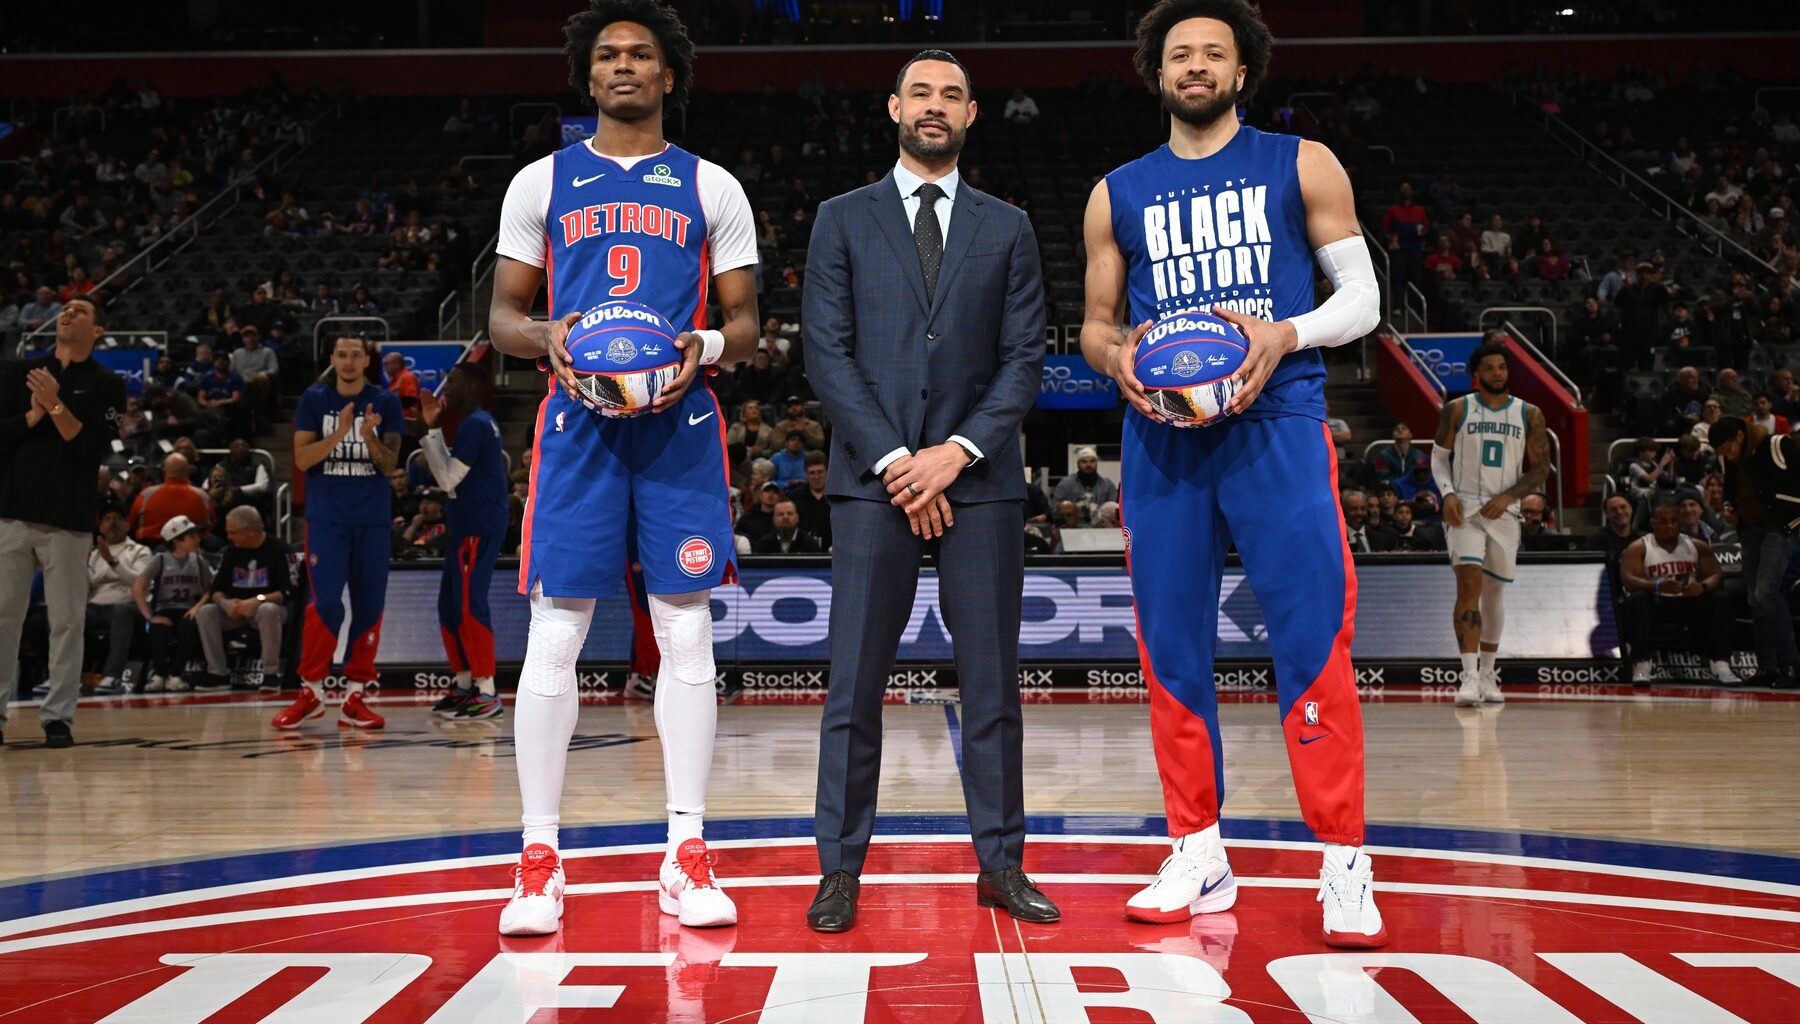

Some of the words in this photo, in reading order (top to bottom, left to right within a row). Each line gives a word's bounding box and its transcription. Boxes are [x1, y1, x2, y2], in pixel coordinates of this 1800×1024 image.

[644, 175, 680, 186] StockX
[1155, 185, 1210, 202] BUILT
[1226, 178, 1247, 188] BY
[559, 202, 691, 248] DETROIT
[1144, 185, 1272, 262] BLACK
[608, 245, 641, 297] 9
[1152, 245, 1272, 301] HISTORY
[1156, 290, 1240, 310] ELEVATED
[1254, 288, 1272, 297] BY
[580, 306, 661, 330] Wilson
[1146, 317, 1227, 346] Wilson
[1042, 366, 1071, 380] DO
[1041, 379, 1111, 394] WORK
[1467, 421, 1522, 439] CHARLOTTE
[1482, 440, 1503, 468] 0
[684, 548, 707, 557] DETROIT
[685, 555, 709, 564] PISTONS
[1656, 650, 1701, 666] Little
[1731, 651, 1760, 667] Litt
[742, 671, 823, 688] StockX
[1214, 669, 1268, 686] ockX
[1538, 667, 1619, 683] StockX
